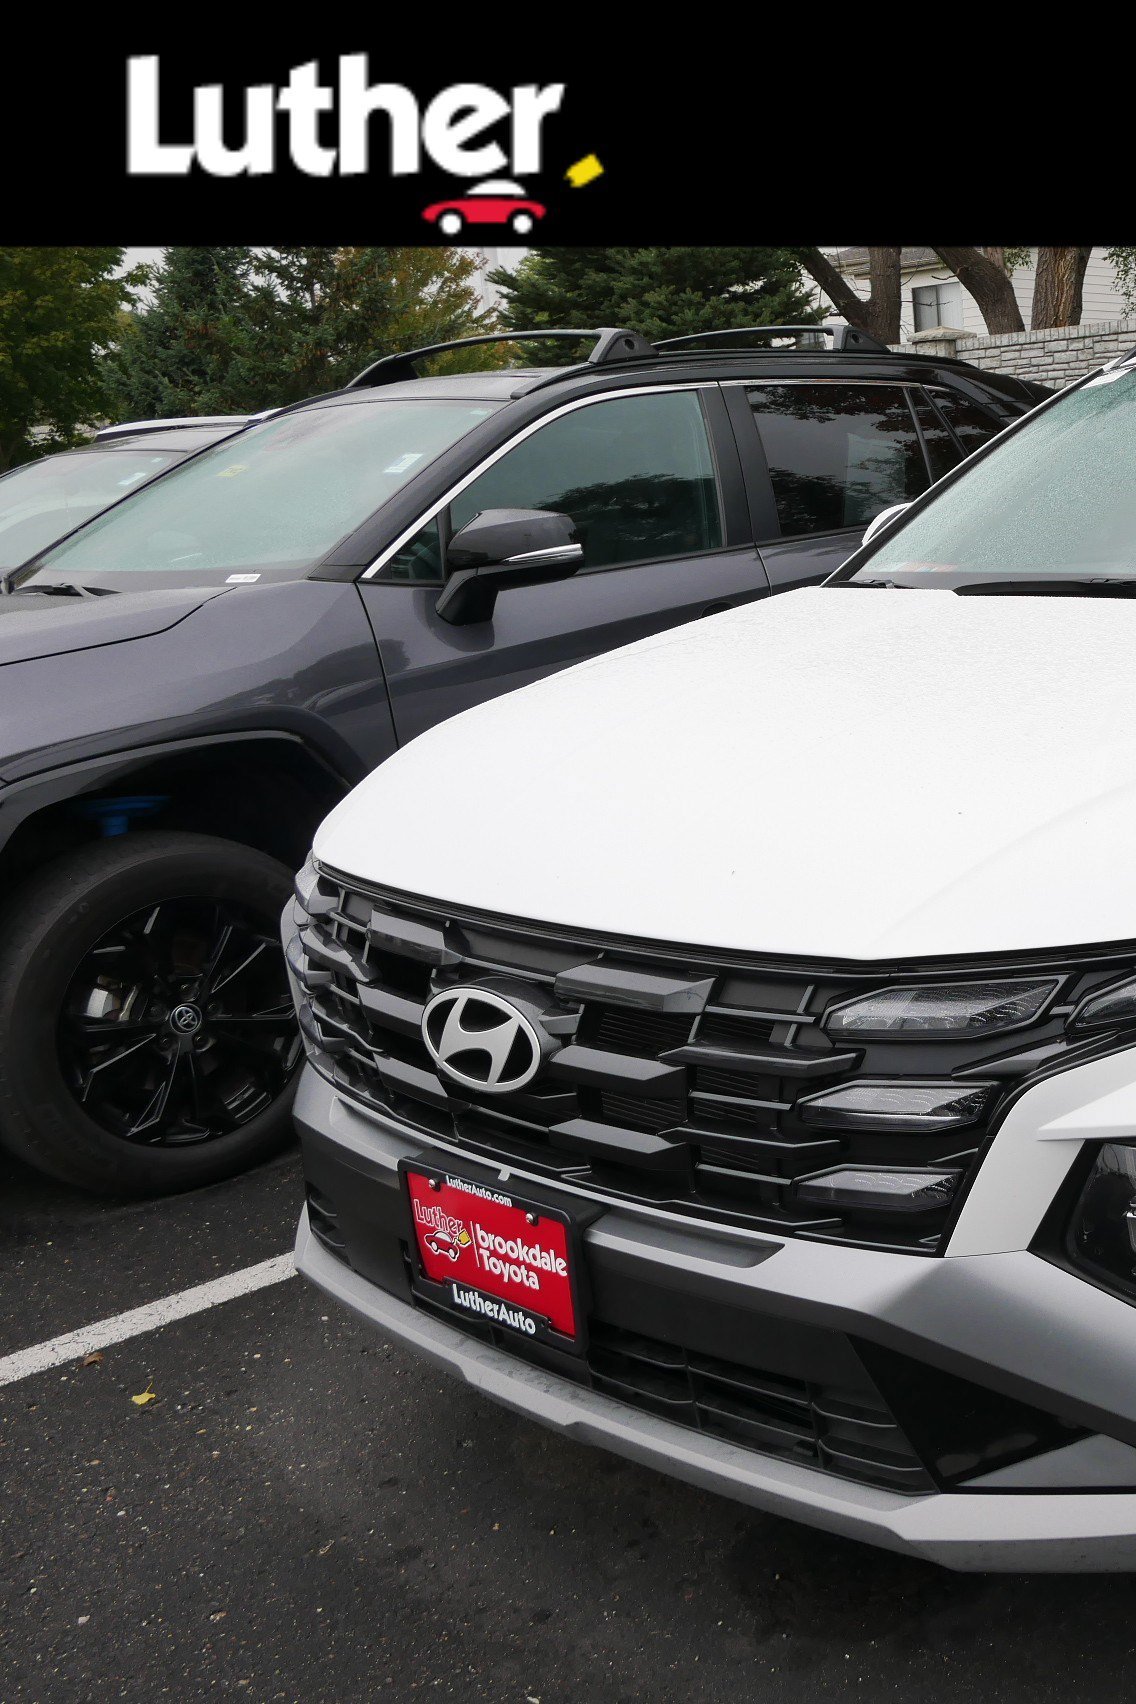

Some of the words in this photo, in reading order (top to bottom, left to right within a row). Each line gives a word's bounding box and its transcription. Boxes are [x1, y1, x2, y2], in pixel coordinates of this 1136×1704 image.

[445, 1174, 513, 1207] LutherAuto.com
[413, 1198, 463, 1235] Luther
[475, 1223, 568, 1277] brookdale
[479, 1250, 540, 1290] Toyota
[452, 1283, 536, 1335] LutherAuto
